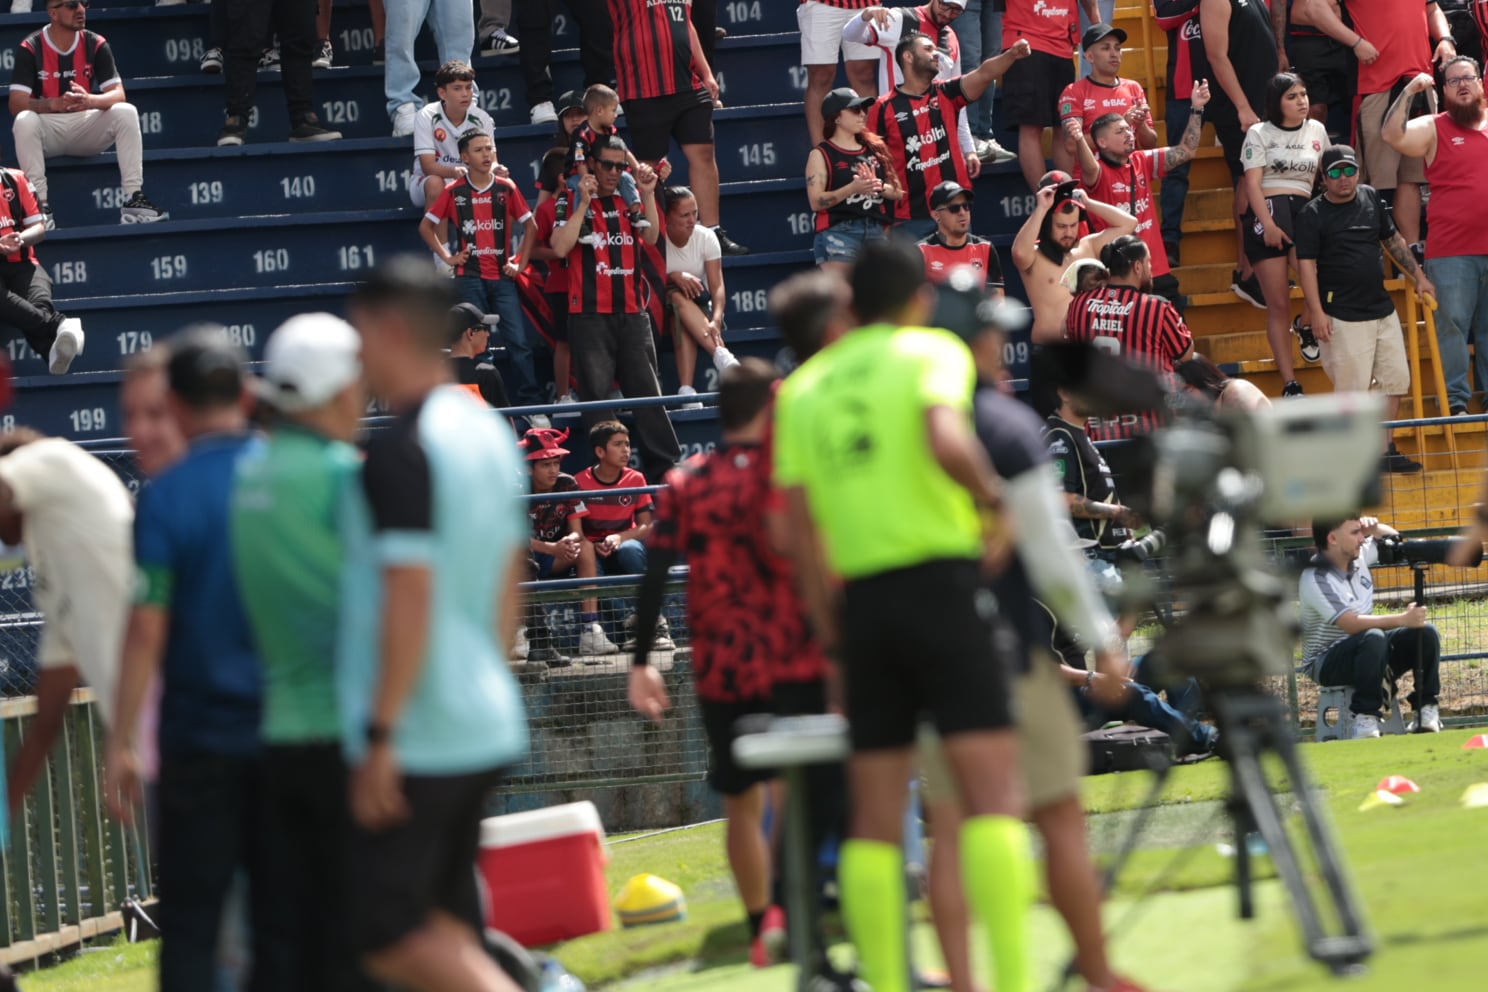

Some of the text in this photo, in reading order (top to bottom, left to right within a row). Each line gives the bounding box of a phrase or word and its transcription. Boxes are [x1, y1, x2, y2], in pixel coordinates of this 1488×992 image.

[669, 7, 683, 21] 12
[727, 0, 761, 23] 104
[166, 39, 204, 61] 098
[323, 101, 359, 124] 120
[740, 144, 775, 166] 145
[281, 176, 314, 198] 140
[376, 170, 409, 191] 141
[92, 187, 125, 209] 138
[189, 182, 223, 204] 139
[1002, 196, 1036, 217] 168
[151, 256, 188, 278] 159
[254, 250, 288, 272] 160
[339, 246, 374, 268] 161
[54, 262, 87, 283] 158
[732, 290, 767, 311] 186
[1087, 298, 1131, 316] Tropical
[1092, 318, 1123, 332] ARIEL
[118, 332, 152, 354] 179
[70, 409, 105, 431] 199
